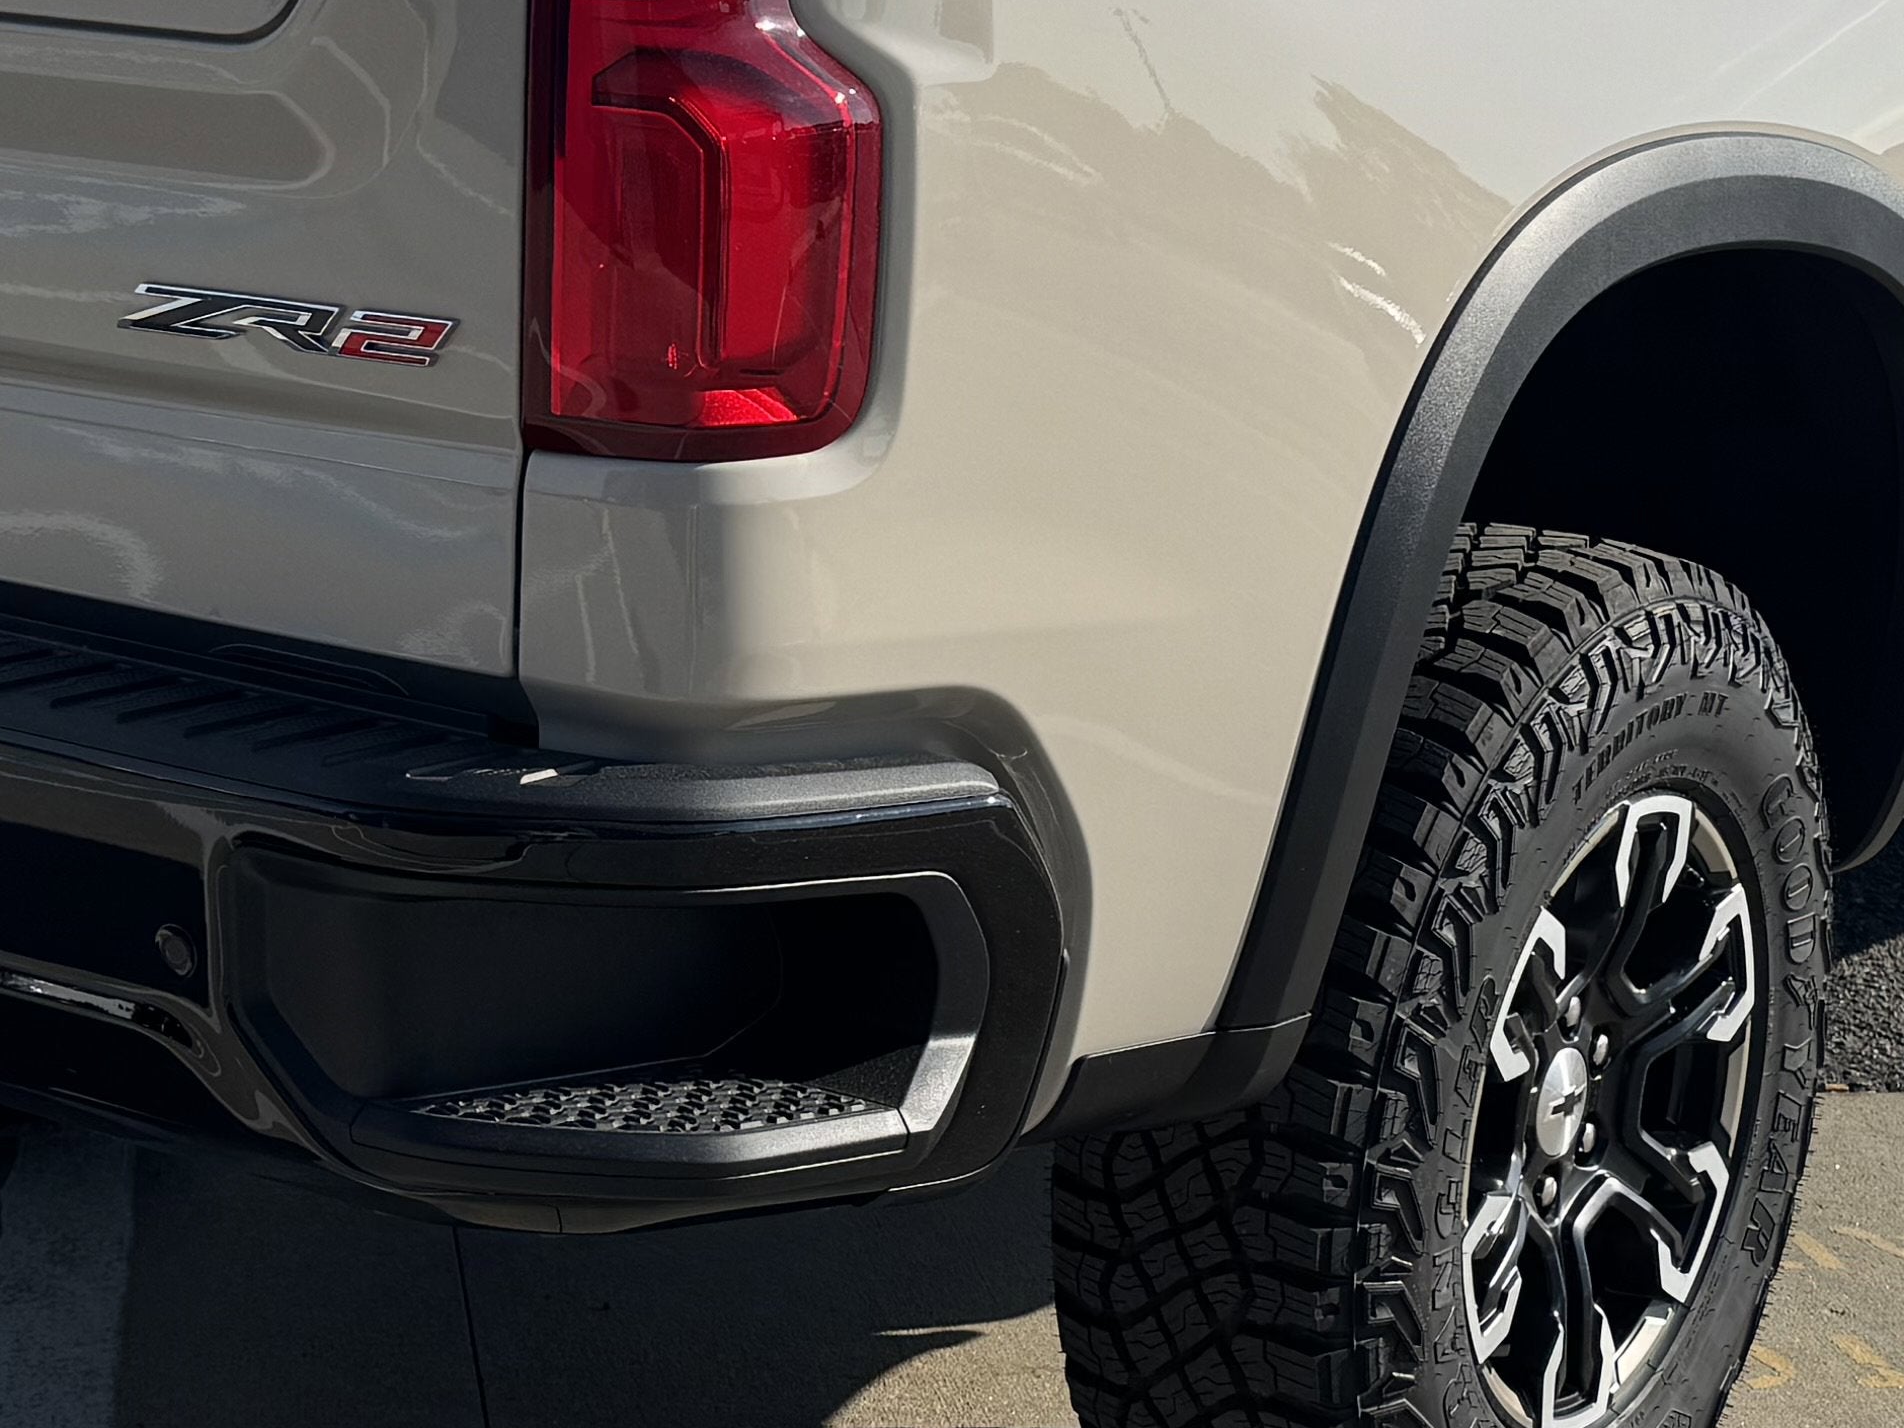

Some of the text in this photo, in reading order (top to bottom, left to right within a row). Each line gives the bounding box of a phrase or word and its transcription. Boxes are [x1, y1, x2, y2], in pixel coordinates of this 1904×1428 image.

[116, 282, 462, 369] ZR2
[1571, 691, 1689, 805] TERRITORY
[1740, 772, 1818, 1269] GOODYEAR
